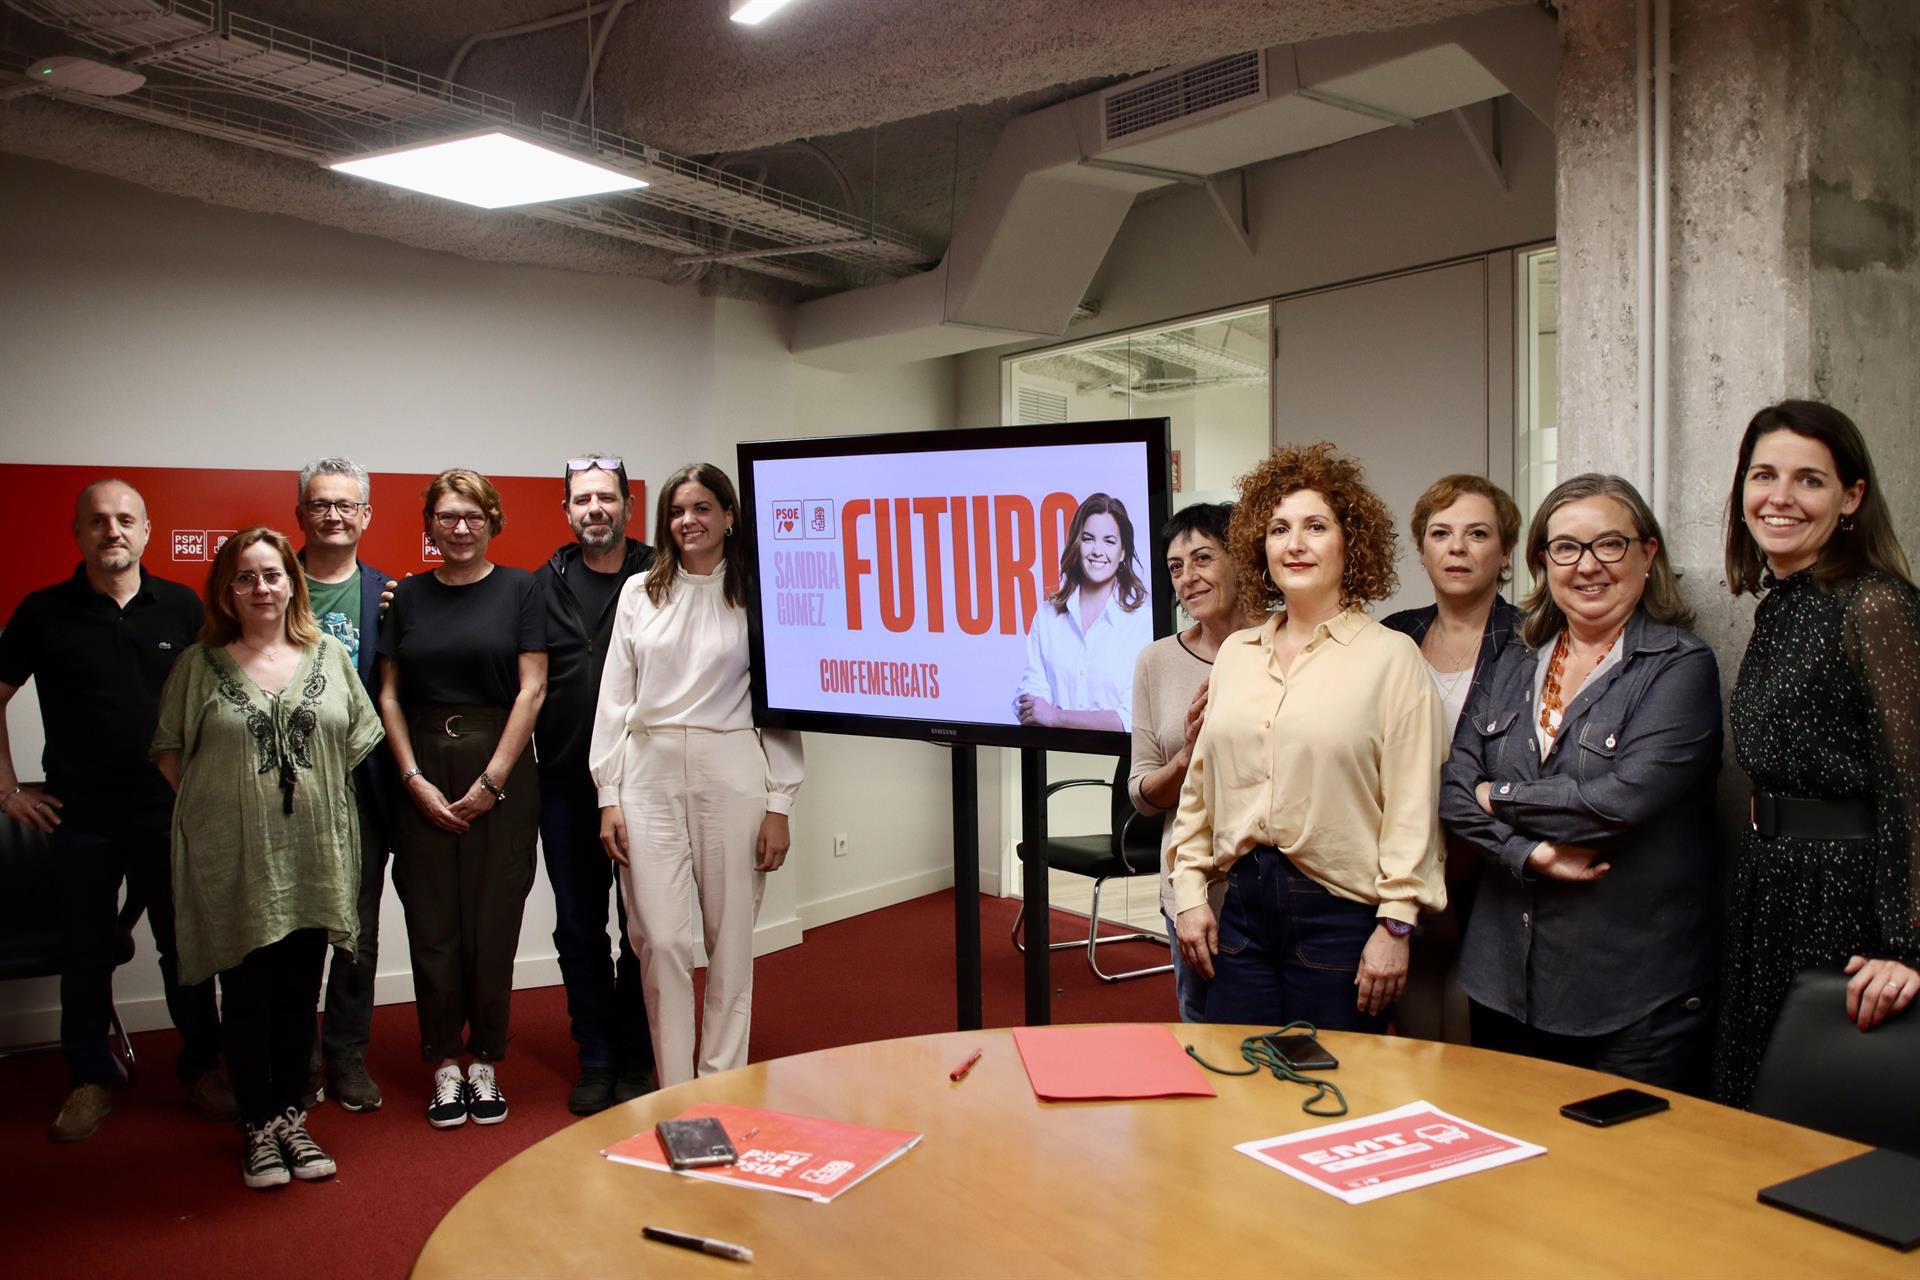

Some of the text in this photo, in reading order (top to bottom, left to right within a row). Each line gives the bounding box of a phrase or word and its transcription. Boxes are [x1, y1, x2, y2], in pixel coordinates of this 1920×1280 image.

[775, 508, 799, 520] PSOE
[175, 535, 203, 543] PSPV
[175, 544, 203, 554] PSOE
[774, 551, 840, 589] SANDRA
[776, 589, 826, 626] GÓMEZ
[820, 658, 940, 699] CONFEMERCATS
[739, 1149, 809, 1166] PSPV
[1297, 1132, 1407, 1165] EMT
